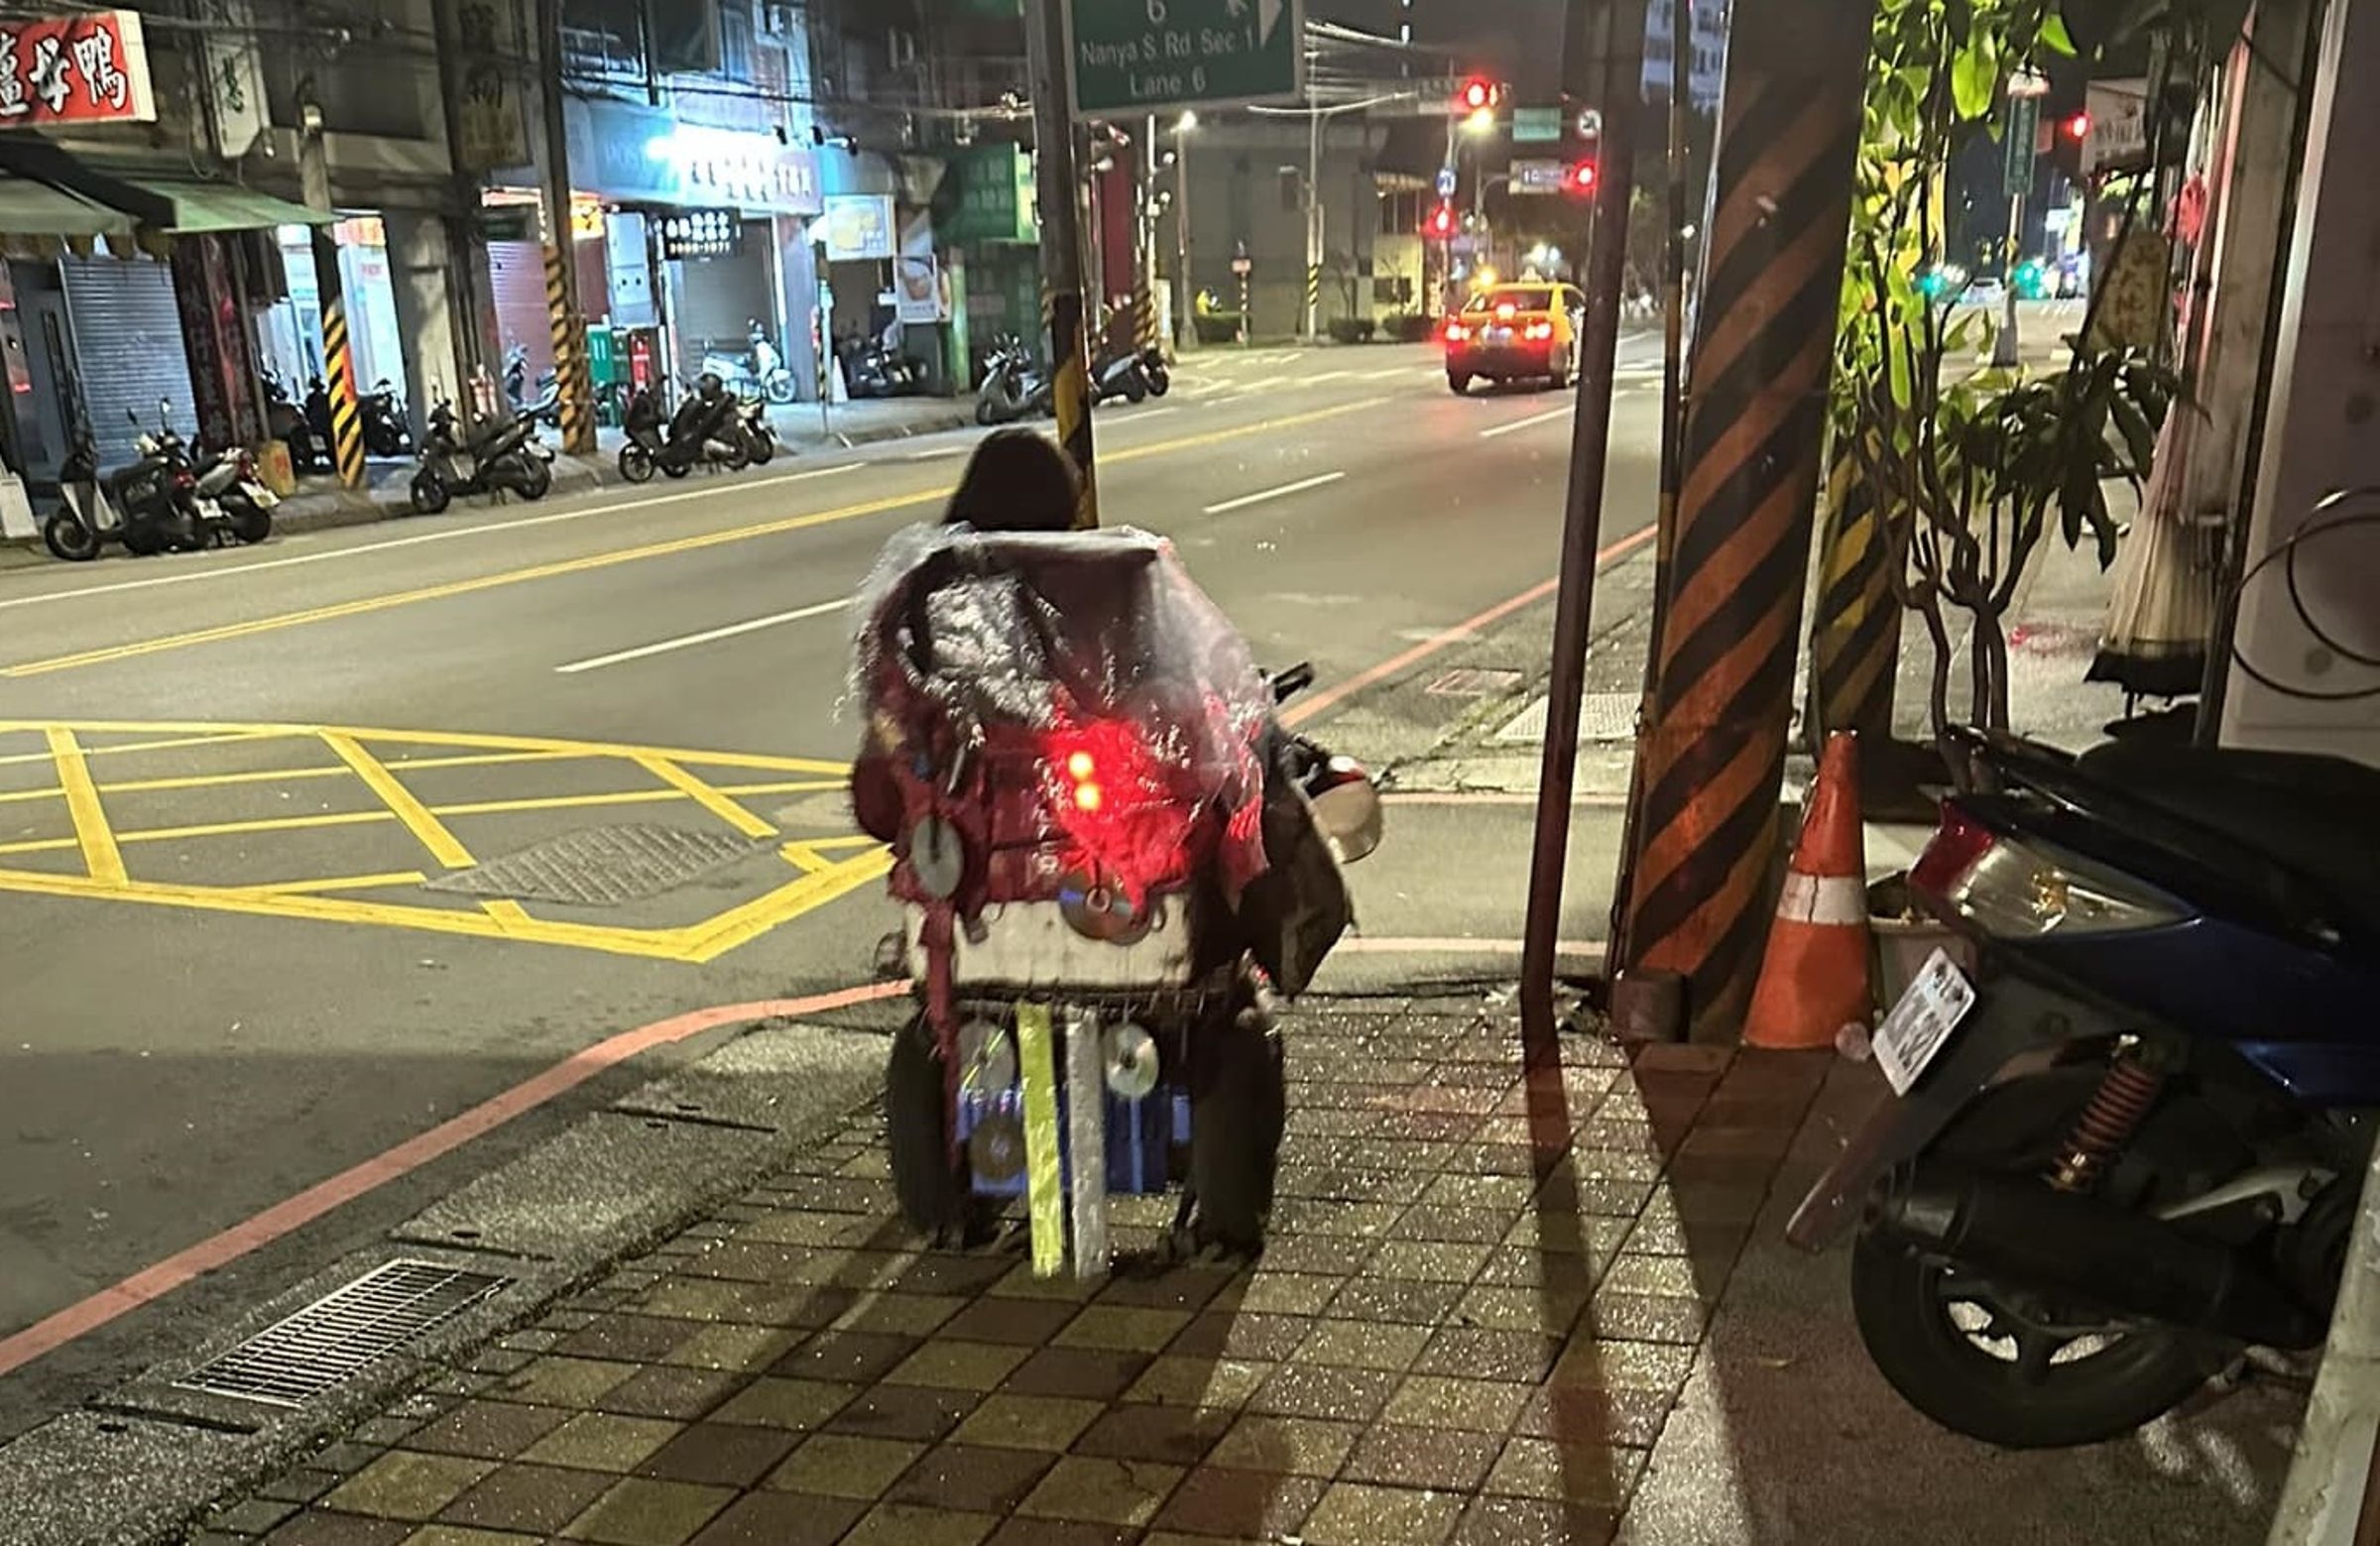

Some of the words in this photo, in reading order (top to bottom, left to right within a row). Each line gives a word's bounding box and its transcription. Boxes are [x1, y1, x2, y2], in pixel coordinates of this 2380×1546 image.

[1081, 41, 1138, 68] Nanya
[1130, 71, 1182, 96] Lane
[1192, 65, 1207, 92] 6
